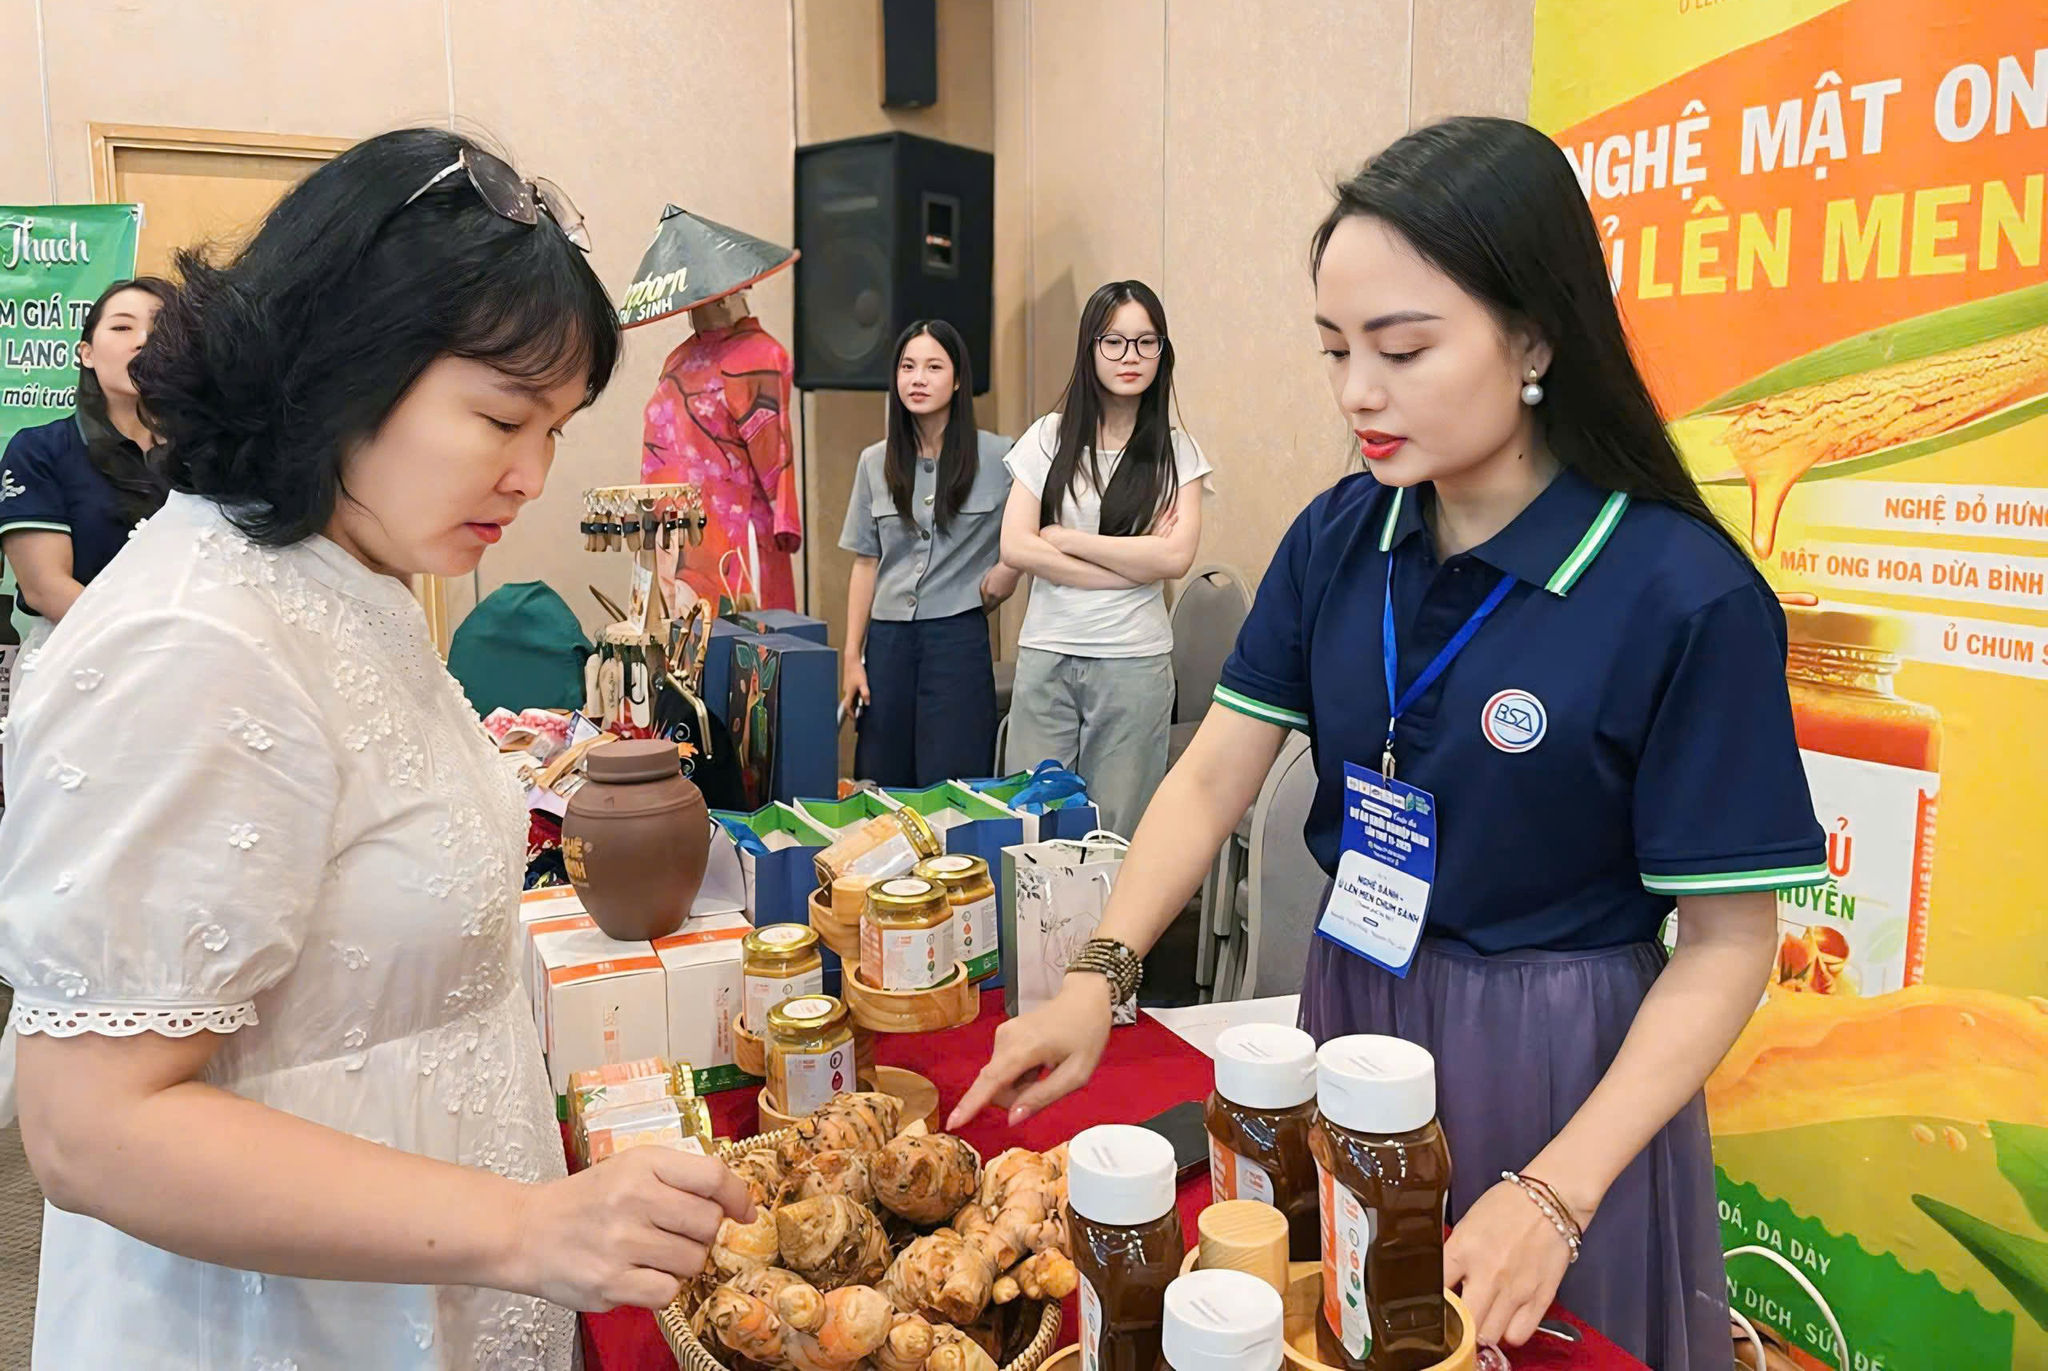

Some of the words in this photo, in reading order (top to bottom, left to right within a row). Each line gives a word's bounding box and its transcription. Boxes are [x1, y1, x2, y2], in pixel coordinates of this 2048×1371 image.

[1562, 99, 1710, 201] NGHỆ
[1740, 70, 1902, 180] MẬT
[0, 217, 90, 269] Thạch
[1637, 195, 1792, 299] LÊN
[1822, 174, 2045, 284] MEN
[23, 294, 63, 328] GIÁ
[636, 297, 673, 322] SINH
[7, 340, 68, 374] LẠNG
[3, 383, 39, 405] môi
[1885, 494, 1947, 526] NGHỆ
[1955, 493, 1987, 523] ĐỎ
[1780, 547, 1819, 577] MẬT
[1826, 554, 1869, 578] ONG
[1877, 560, 1922, 583] HOA
[1932, 559, 1979, 589] DỪA
[1988, 564, 2044, 595] BÌNH
[1943, 622, 1957, 652] Ủ
[1966, 634, 2034, 663] CHUM
[1827, 816, 1852, 877] Ủ
